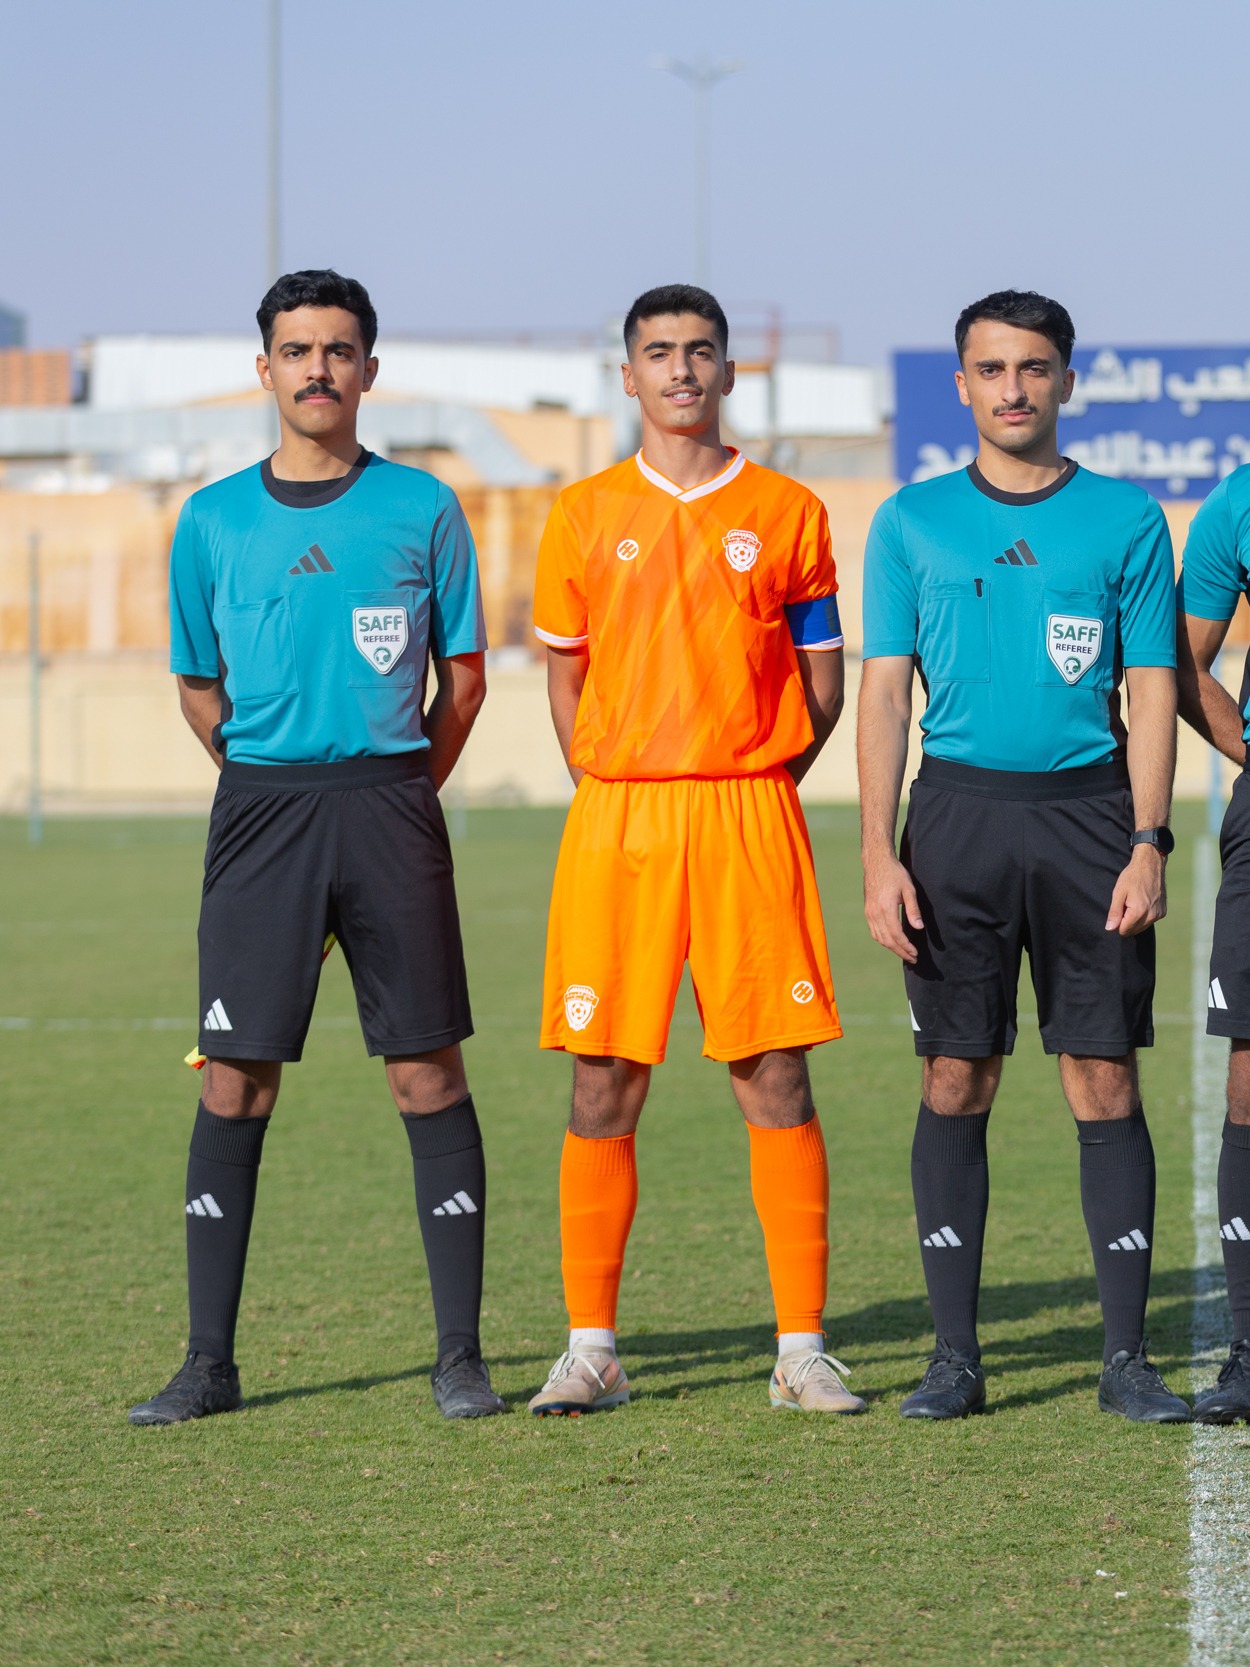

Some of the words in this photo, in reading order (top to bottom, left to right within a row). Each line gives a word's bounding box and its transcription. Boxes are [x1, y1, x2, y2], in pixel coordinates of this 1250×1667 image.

[358, 615, 403, 632] SAFF
[363, 635, 400, 643] REFEREE
[1052, 623, 1099, 643] SAFF
[1055, 643, 1093, 655] REFEREE
